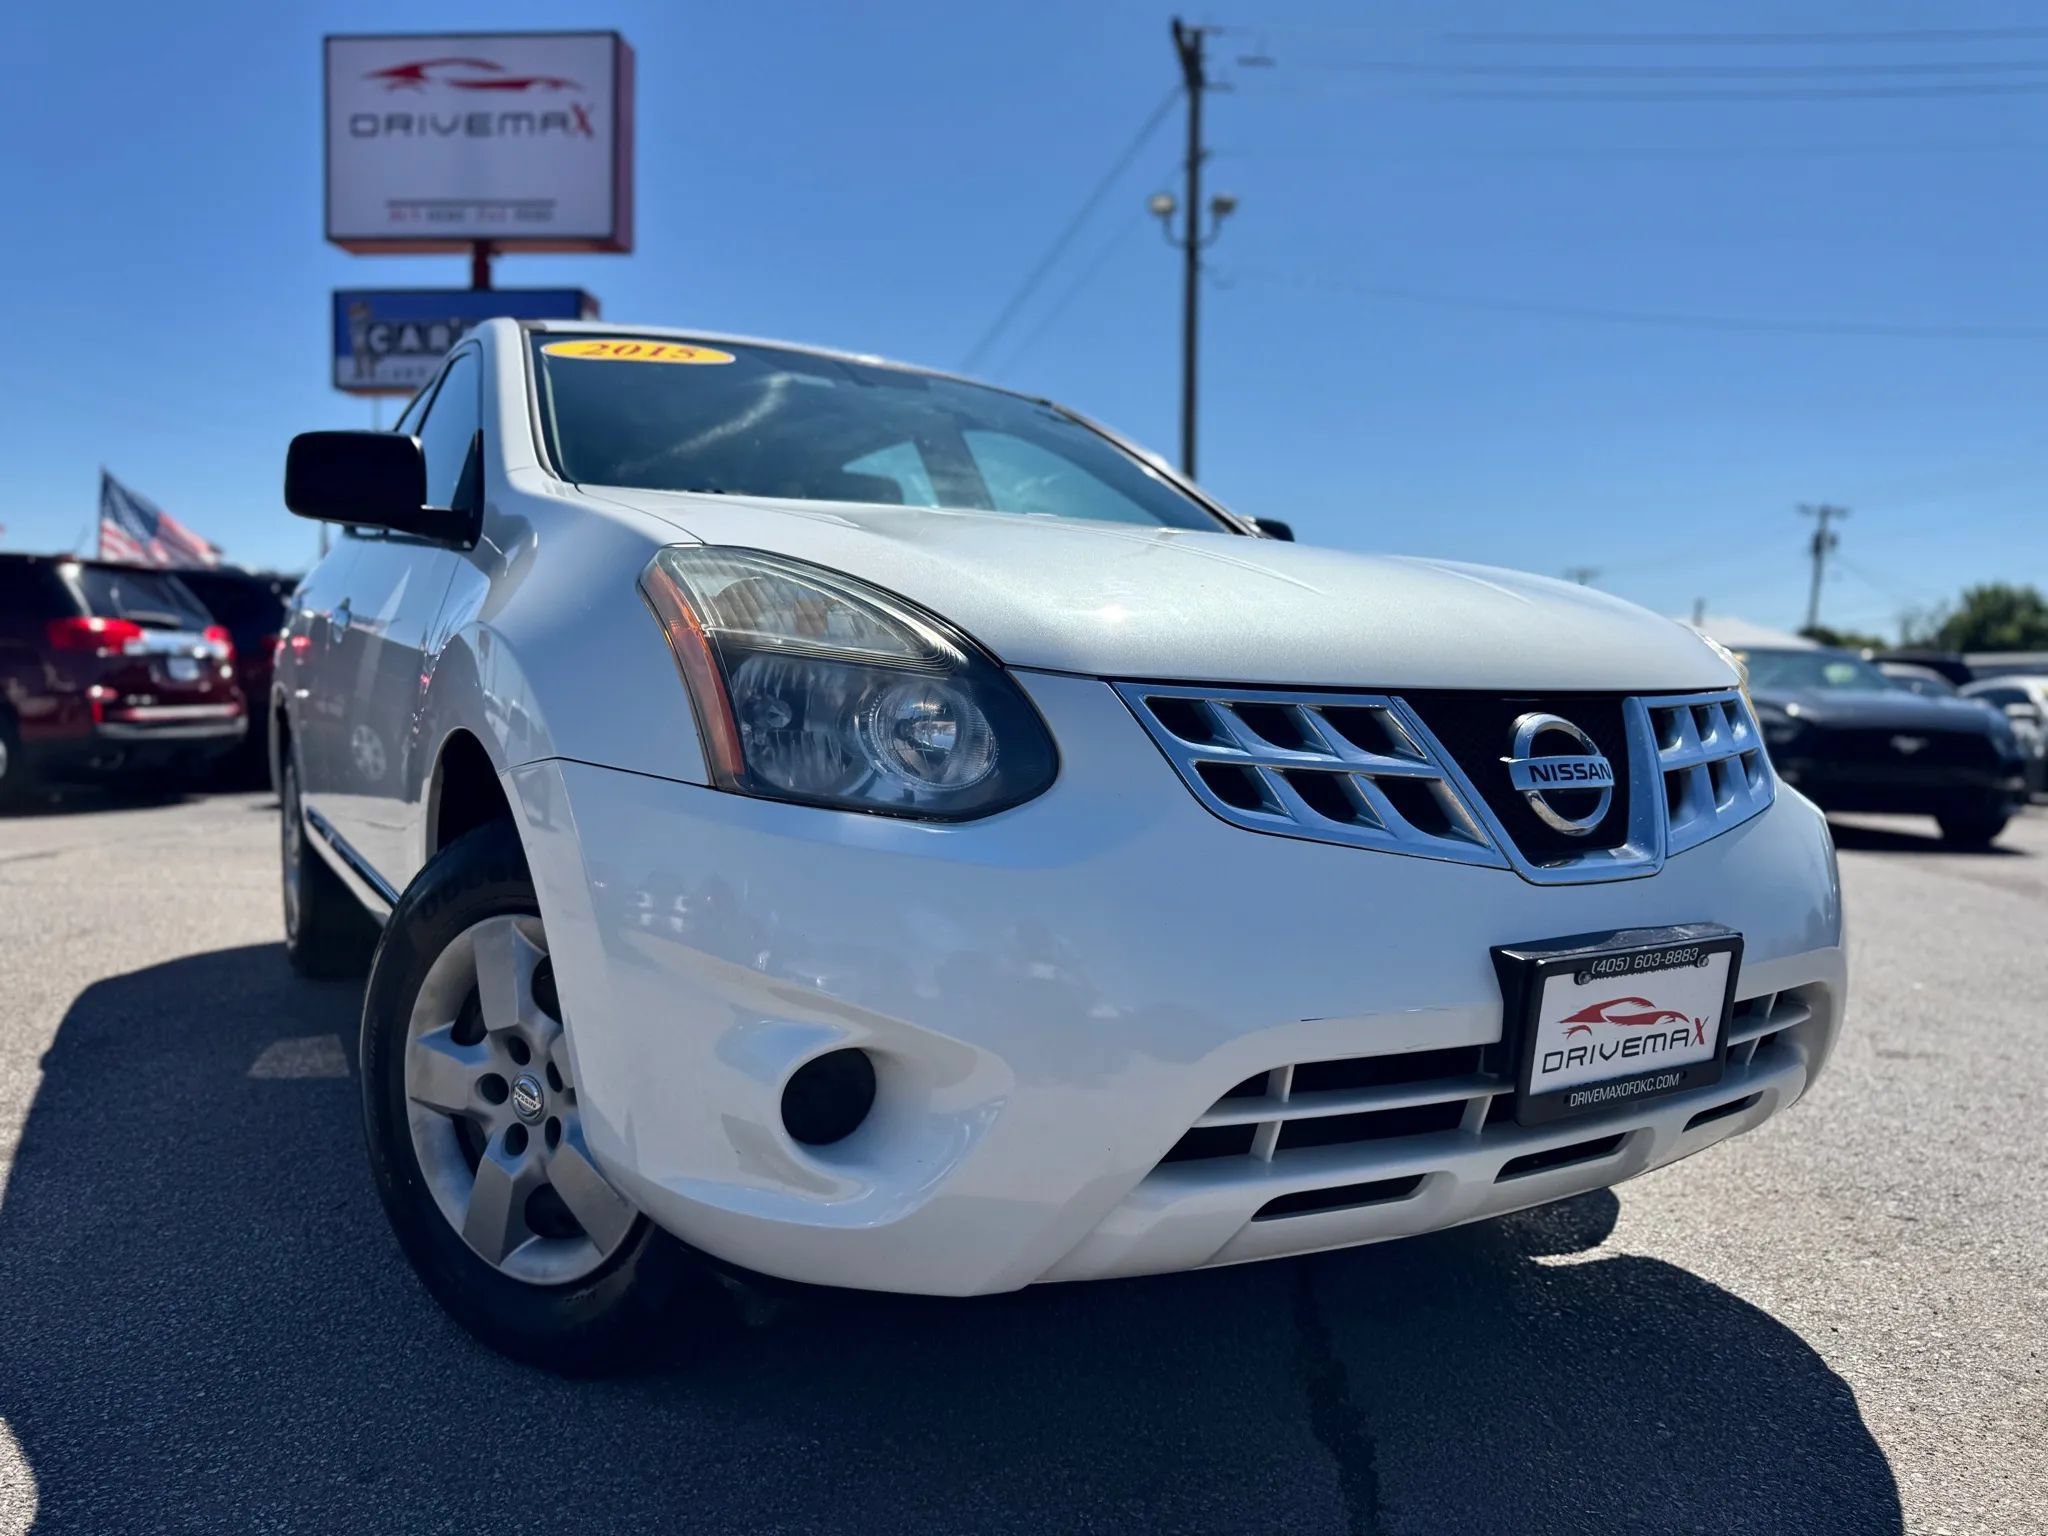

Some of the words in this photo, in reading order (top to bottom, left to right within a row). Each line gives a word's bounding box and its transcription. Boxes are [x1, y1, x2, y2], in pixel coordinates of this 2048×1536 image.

[349, 102, 594, 140] DRIVEMAX
[580, 342, 700, 360] 2015
[1527, 762, 1613, 784] NISSAN
[1591, 956, 1631, 974] (405)
[1633, 947, 1699, 970] 603-8883
[1541, 1016, 1710, 1075] DRIVEMAX
[1569, 1072, 1681, 1108] DRIVEMAXOFOKC.COM
